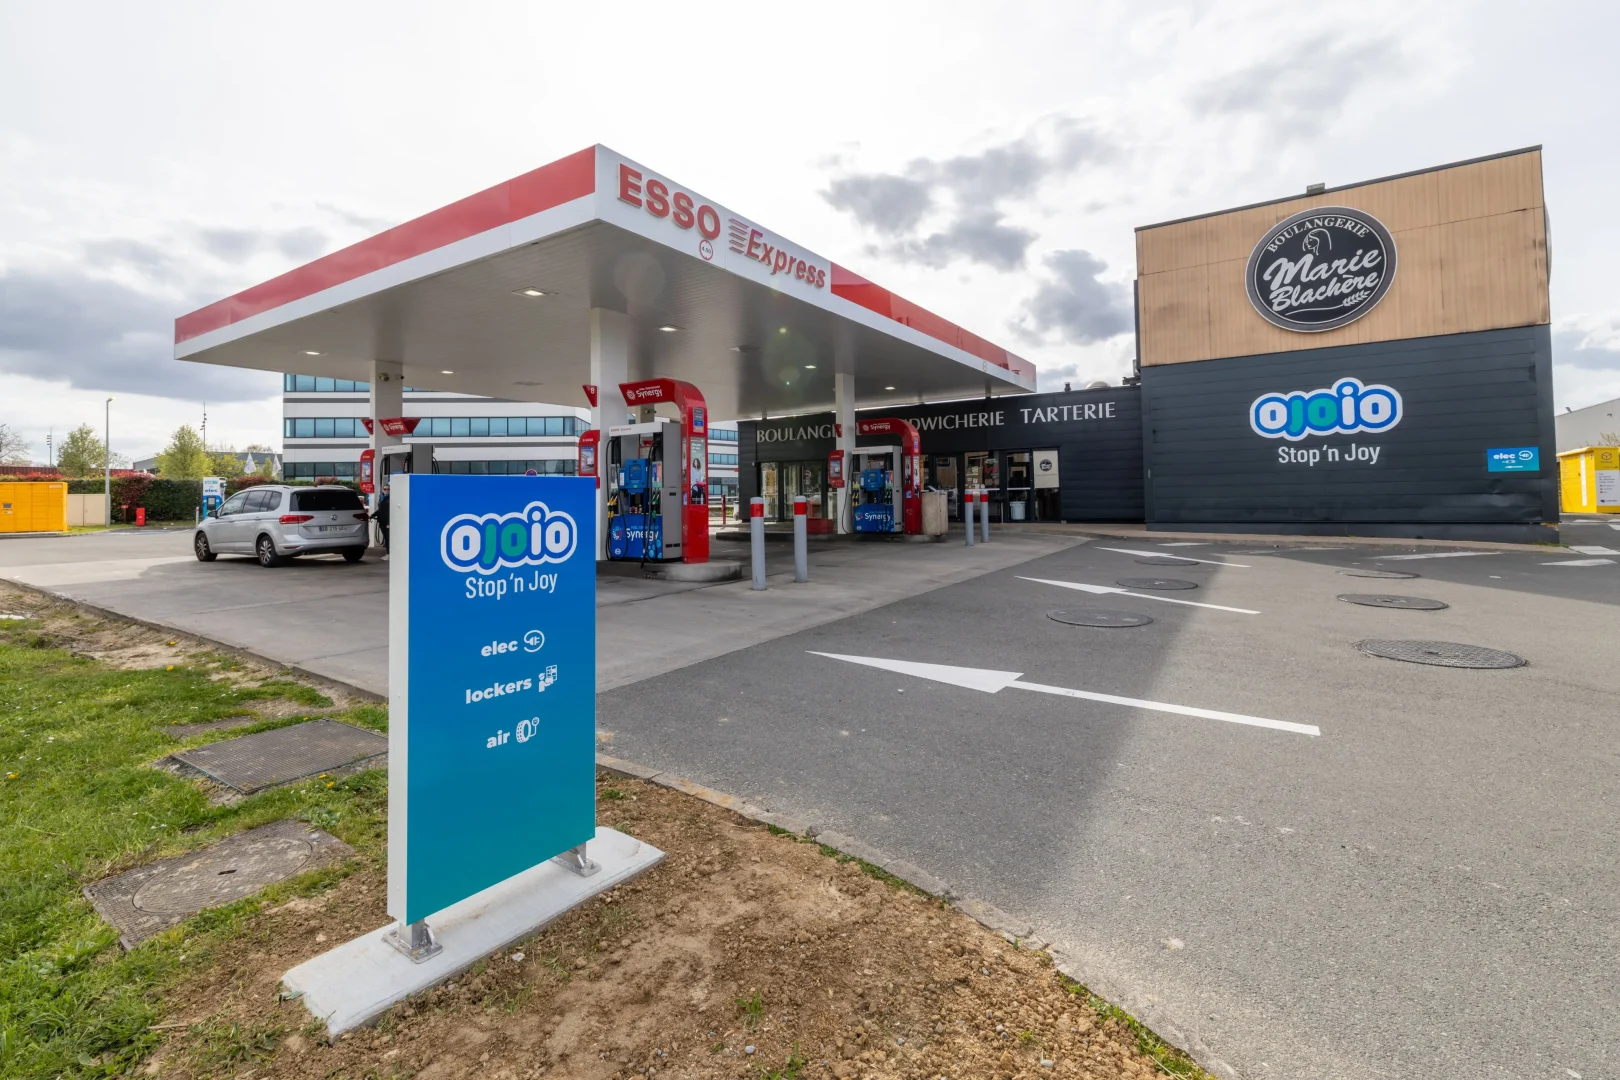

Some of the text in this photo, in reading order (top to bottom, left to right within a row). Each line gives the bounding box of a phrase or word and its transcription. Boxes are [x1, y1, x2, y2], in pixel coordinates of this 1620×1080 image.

[617, 163, 826, 288] ESSO Express
[1266, 217, 1370, 253] BOULANGERIE
[1263, 248, 1382, 291] Marie
[1269, 272, 1379, 312] Blachère
[635, 388, 663, 399] Synergy
[1019, 401, 1116, 424] TARTERIE
[1278, 446, 1320, 467] Stop
[1344, 443, 1381, 465] Joy
[1493, 452, 1516, 460] elec
[465, 576, 507, 600] Stop
[528, 570, 558, 594] Joy
[480, 638, 518, 657] elec
[465, 677, 532, 704] lockers
[486, 729, 511, 749] air
